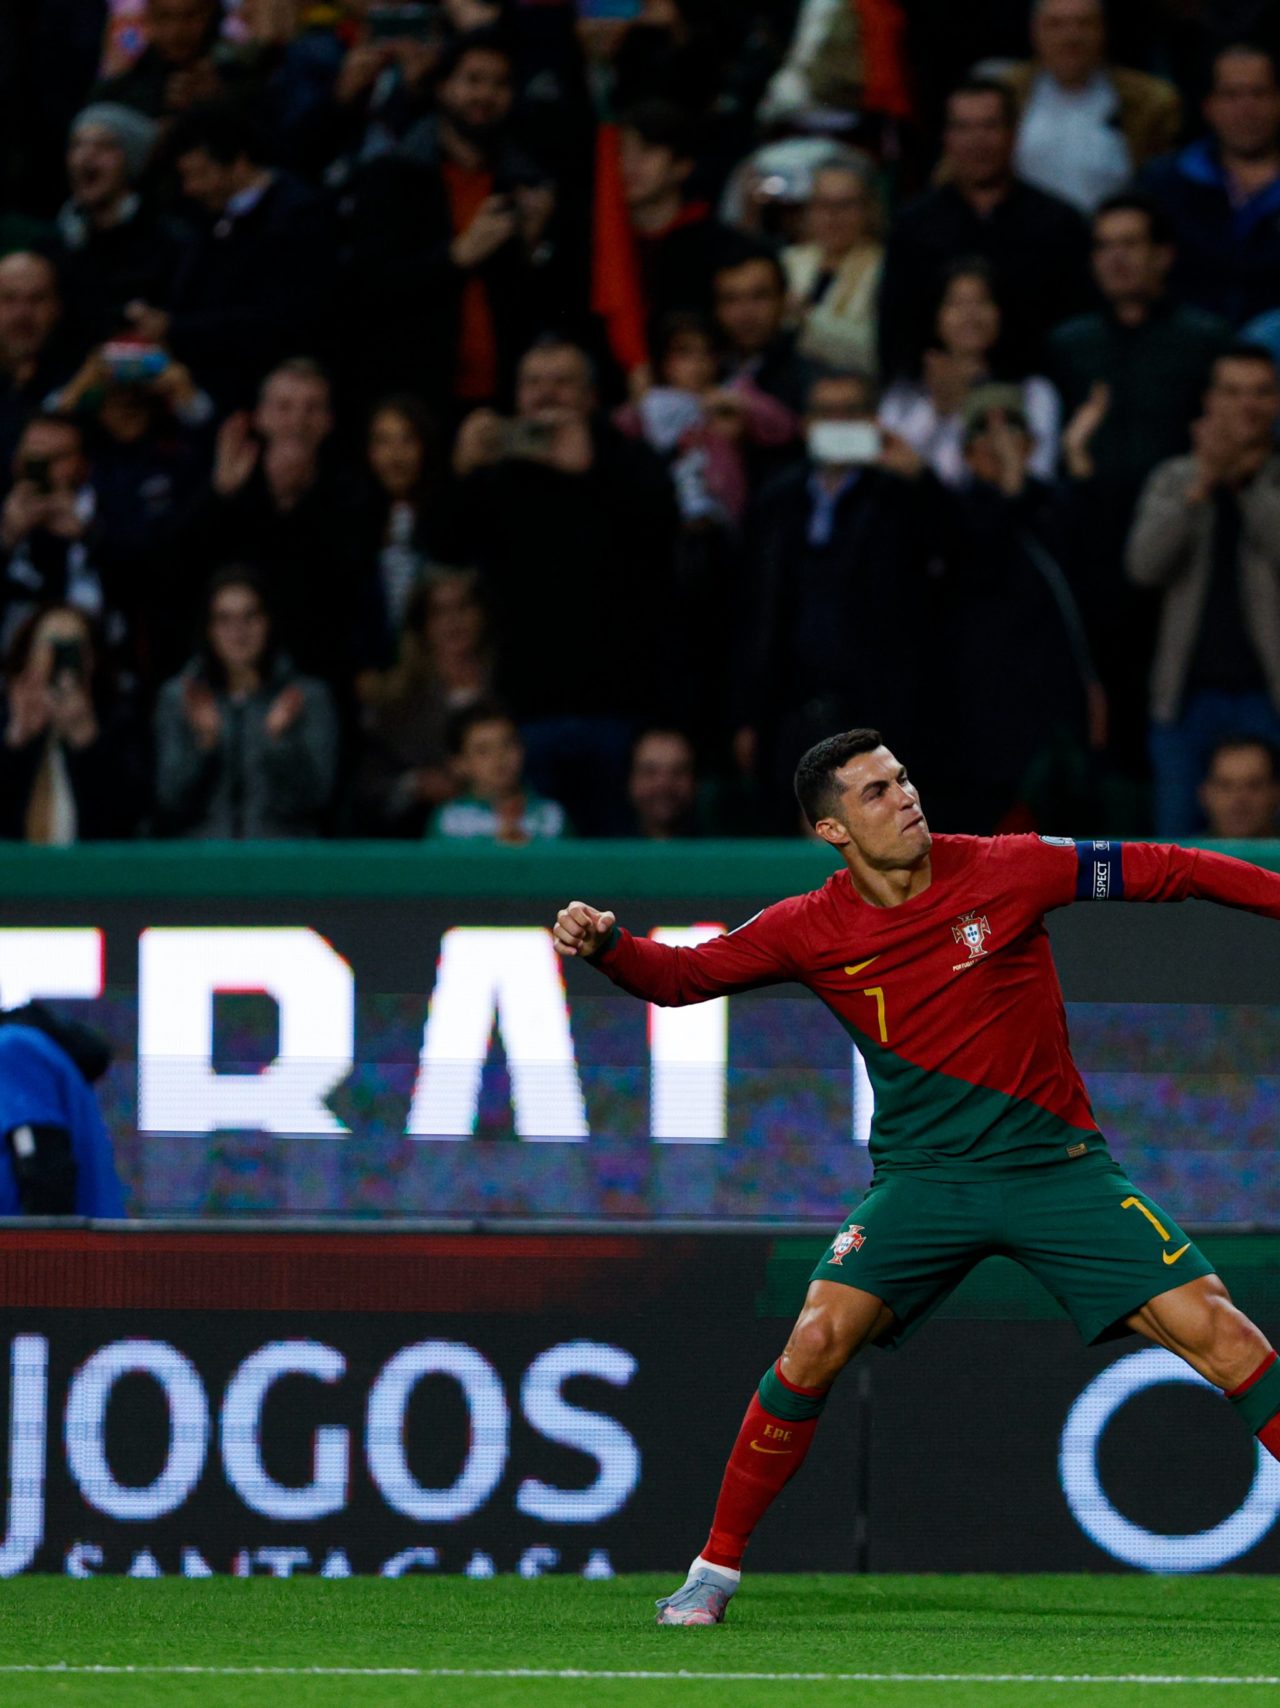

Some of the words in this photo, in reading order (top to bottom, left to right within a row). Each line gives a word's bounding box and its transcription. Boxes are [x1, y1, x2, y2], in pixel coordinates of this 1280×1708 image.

[1096, 861, 1107, 900] ESPECT
[863, 986, 889, 1043] 7
[1120, 1196, 1171, 1242] 7
[0, 1334, 643, 1578] JOGOS
